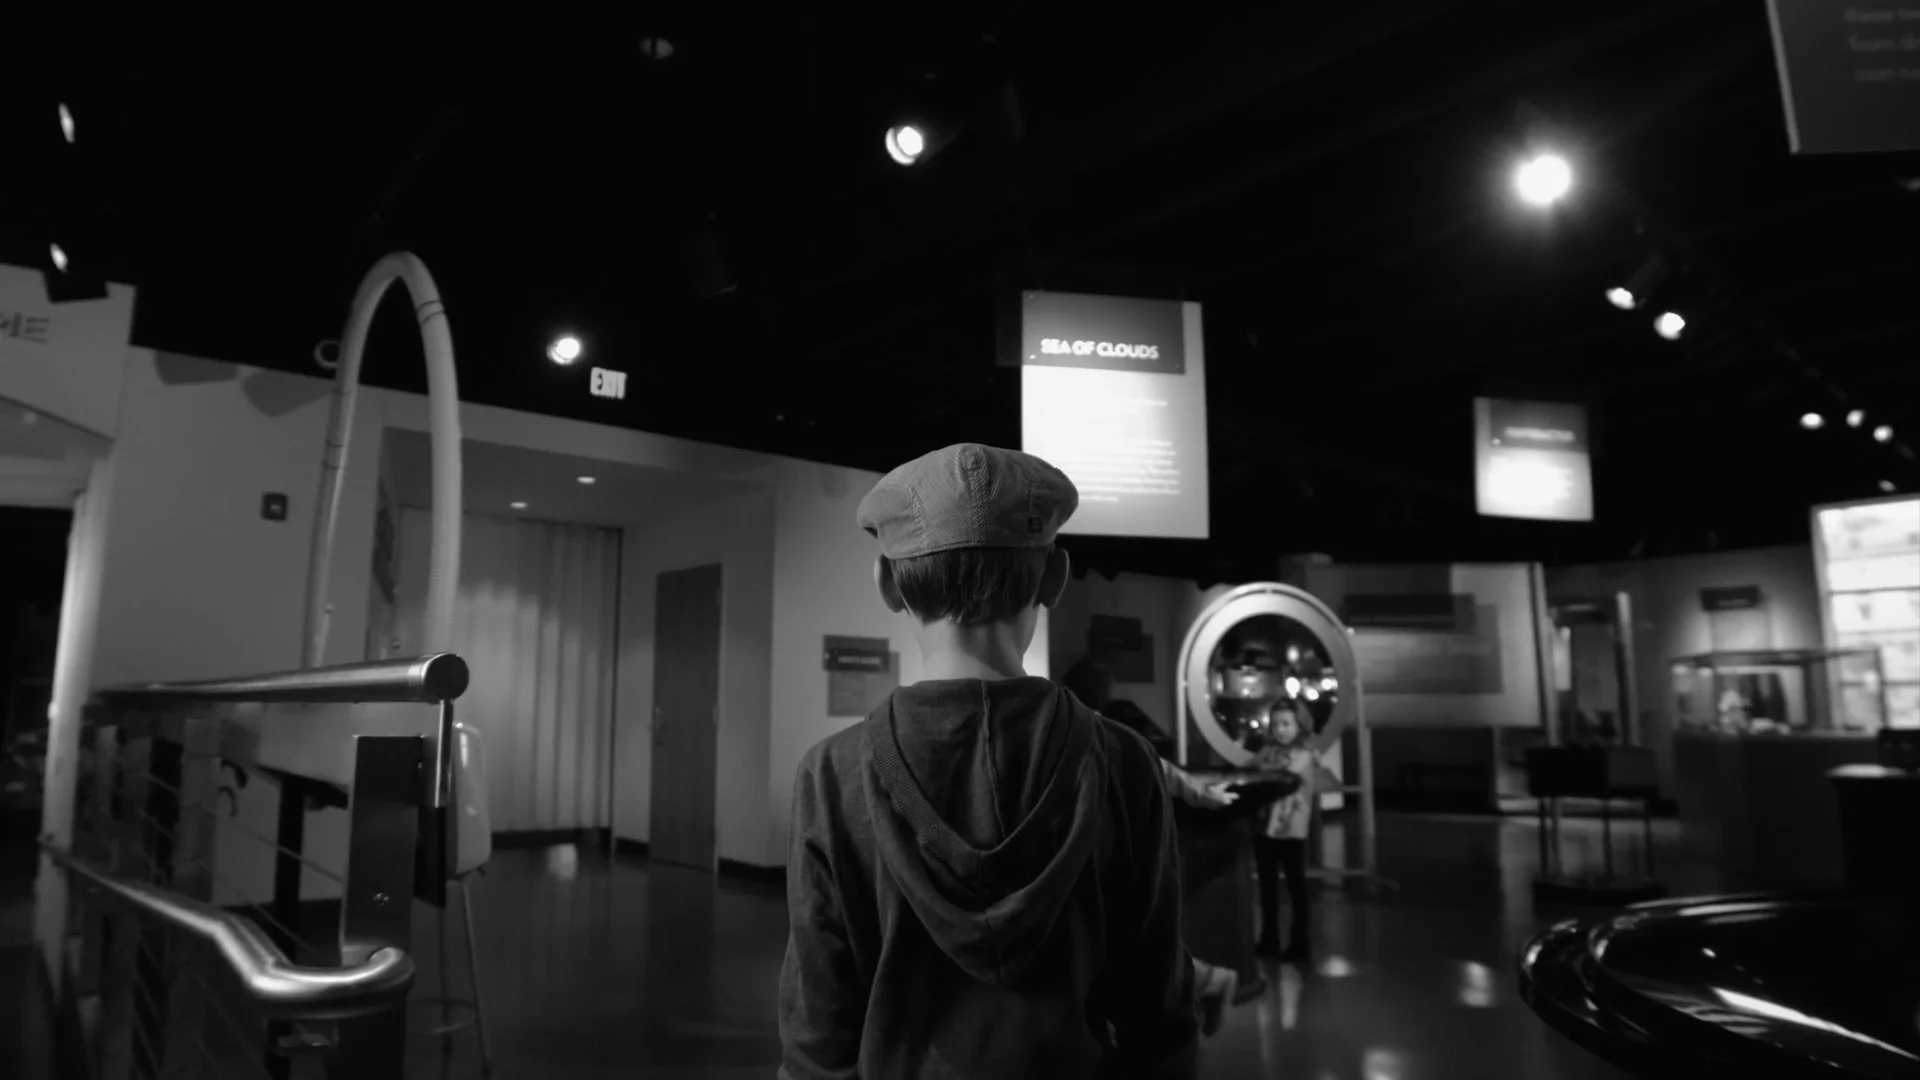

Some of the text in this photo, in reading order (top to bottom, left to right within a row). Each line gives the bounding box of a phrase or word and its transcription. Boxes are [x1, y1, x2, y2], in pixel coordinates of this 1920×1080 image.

[1040, 337, 1160, 359] SEA OF CLOUDS
[590, 366, 627, 399] EXIT
